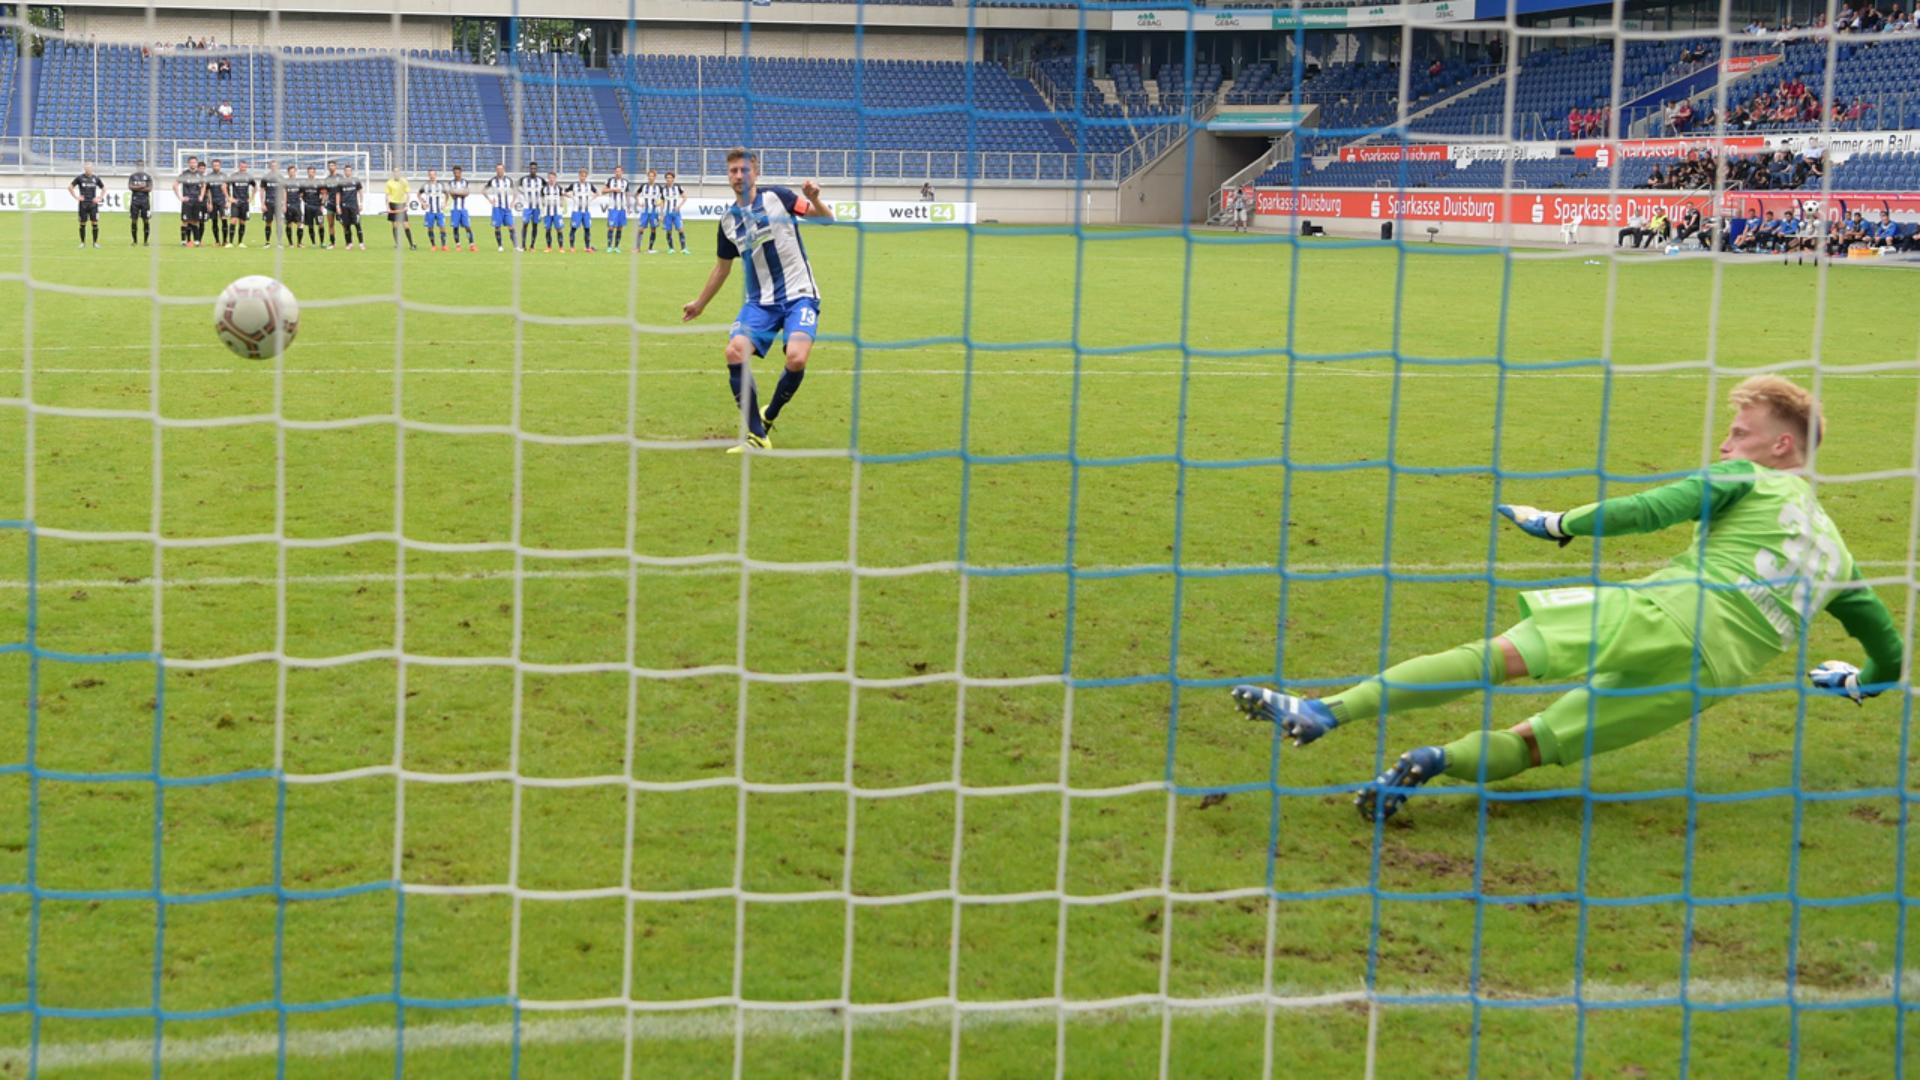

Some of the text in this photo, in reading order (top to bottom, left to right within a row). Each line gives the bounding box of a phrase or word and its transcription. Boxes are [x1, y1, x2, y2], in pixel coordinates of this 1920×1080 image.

[889, 205, 952, 219] wett 24
[1258, 192, 1342, 217] Sparkasse Duisburg
[1388, 195, 1440, 218] Sparkasse
[1443, 196, 1495, 222] Duisburg
[1554, 198, 1621, 223] Sparkasse
[1627, 198, 1690, 223] Duisbur
[800, 307, 816, 324] 13
